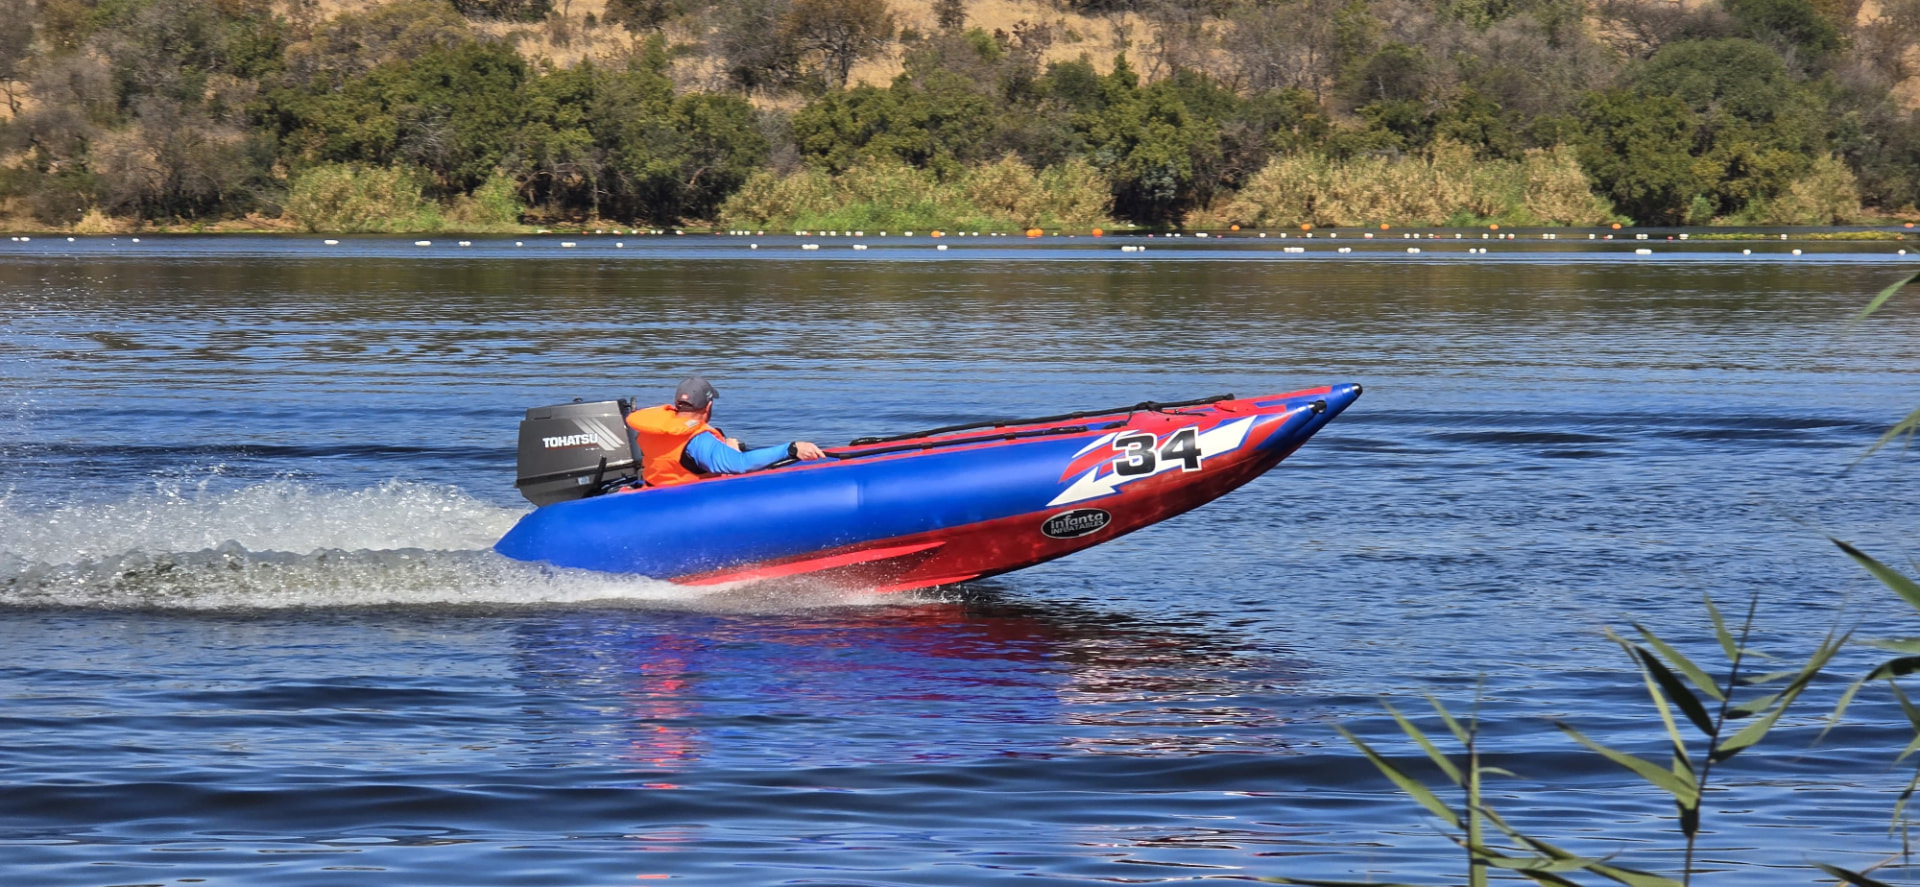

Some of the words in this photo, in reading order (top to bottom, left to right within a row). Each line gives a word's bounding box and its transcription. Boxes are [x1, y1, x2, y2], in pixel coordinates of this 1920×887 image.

[542, 433, 598, 448] TOHATSU
[1113, 427, 1202, 477] 34
[1050, 512, 1104, 529] infanta
